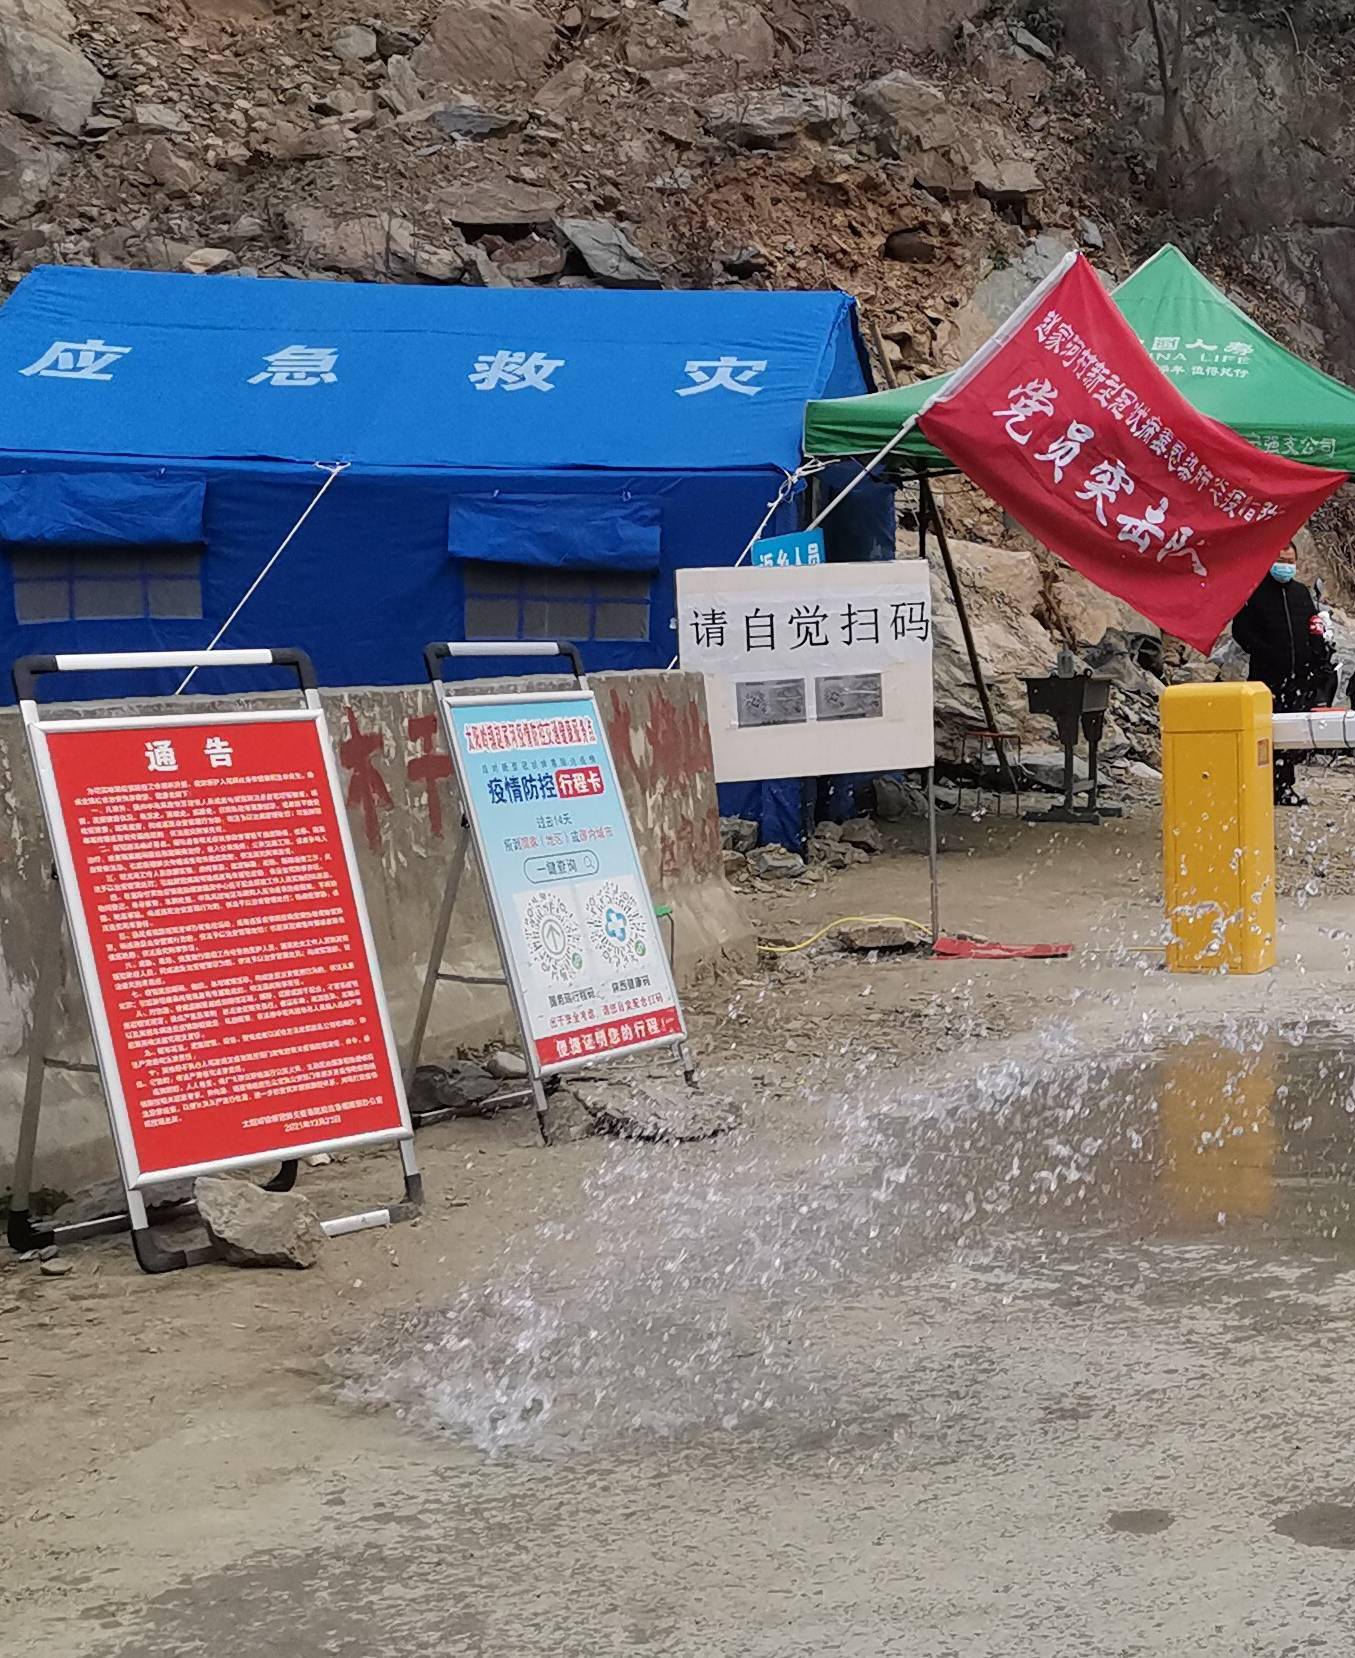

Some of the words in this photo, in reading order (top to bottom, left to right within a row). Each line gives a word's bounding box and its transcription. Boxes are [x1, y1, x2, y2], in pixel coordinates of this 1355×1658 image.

[19, 339, 768, 397] 应急救灾
[1140, 336, 1255, 356] 国人寿
[1148, 352, 1187, 361] INA
[1200, 353, 1251, 365] LIFE
[991, 376, 1209, 577] 党员突击队
[689, 600, 930, 652] 请自觉扫码
[143, 736, 235, 773] 通告
